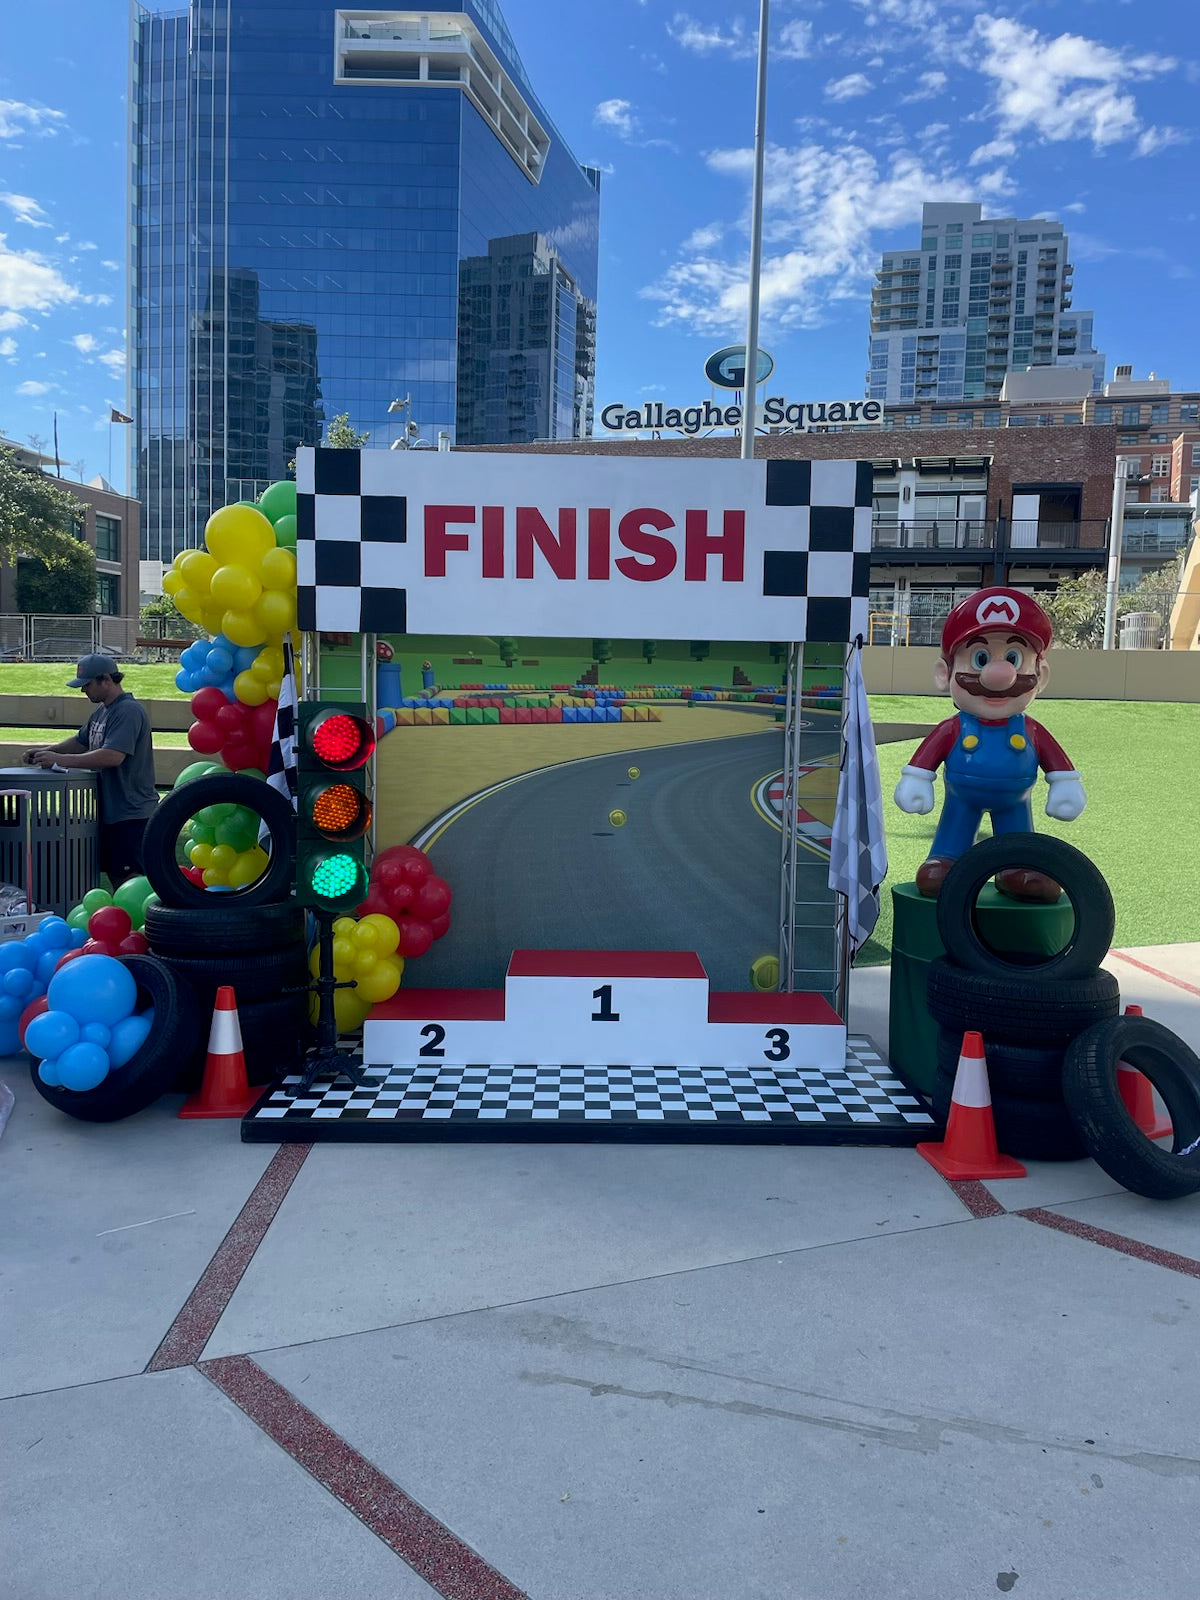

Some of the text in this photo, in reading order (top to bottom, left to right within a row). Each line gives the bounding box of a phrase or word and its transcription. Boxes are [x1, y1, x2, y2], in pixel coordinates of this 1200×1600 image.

[601, 398, 881, 434] Gallaghe Square
[423, 505, 744, 582] FINISH
[982, 601, 1015, 621] M
[591, 985, 620, 1022] 1
[419, 1024, 446, 1057] 2
[763, 1028, 791, 1062] 3
